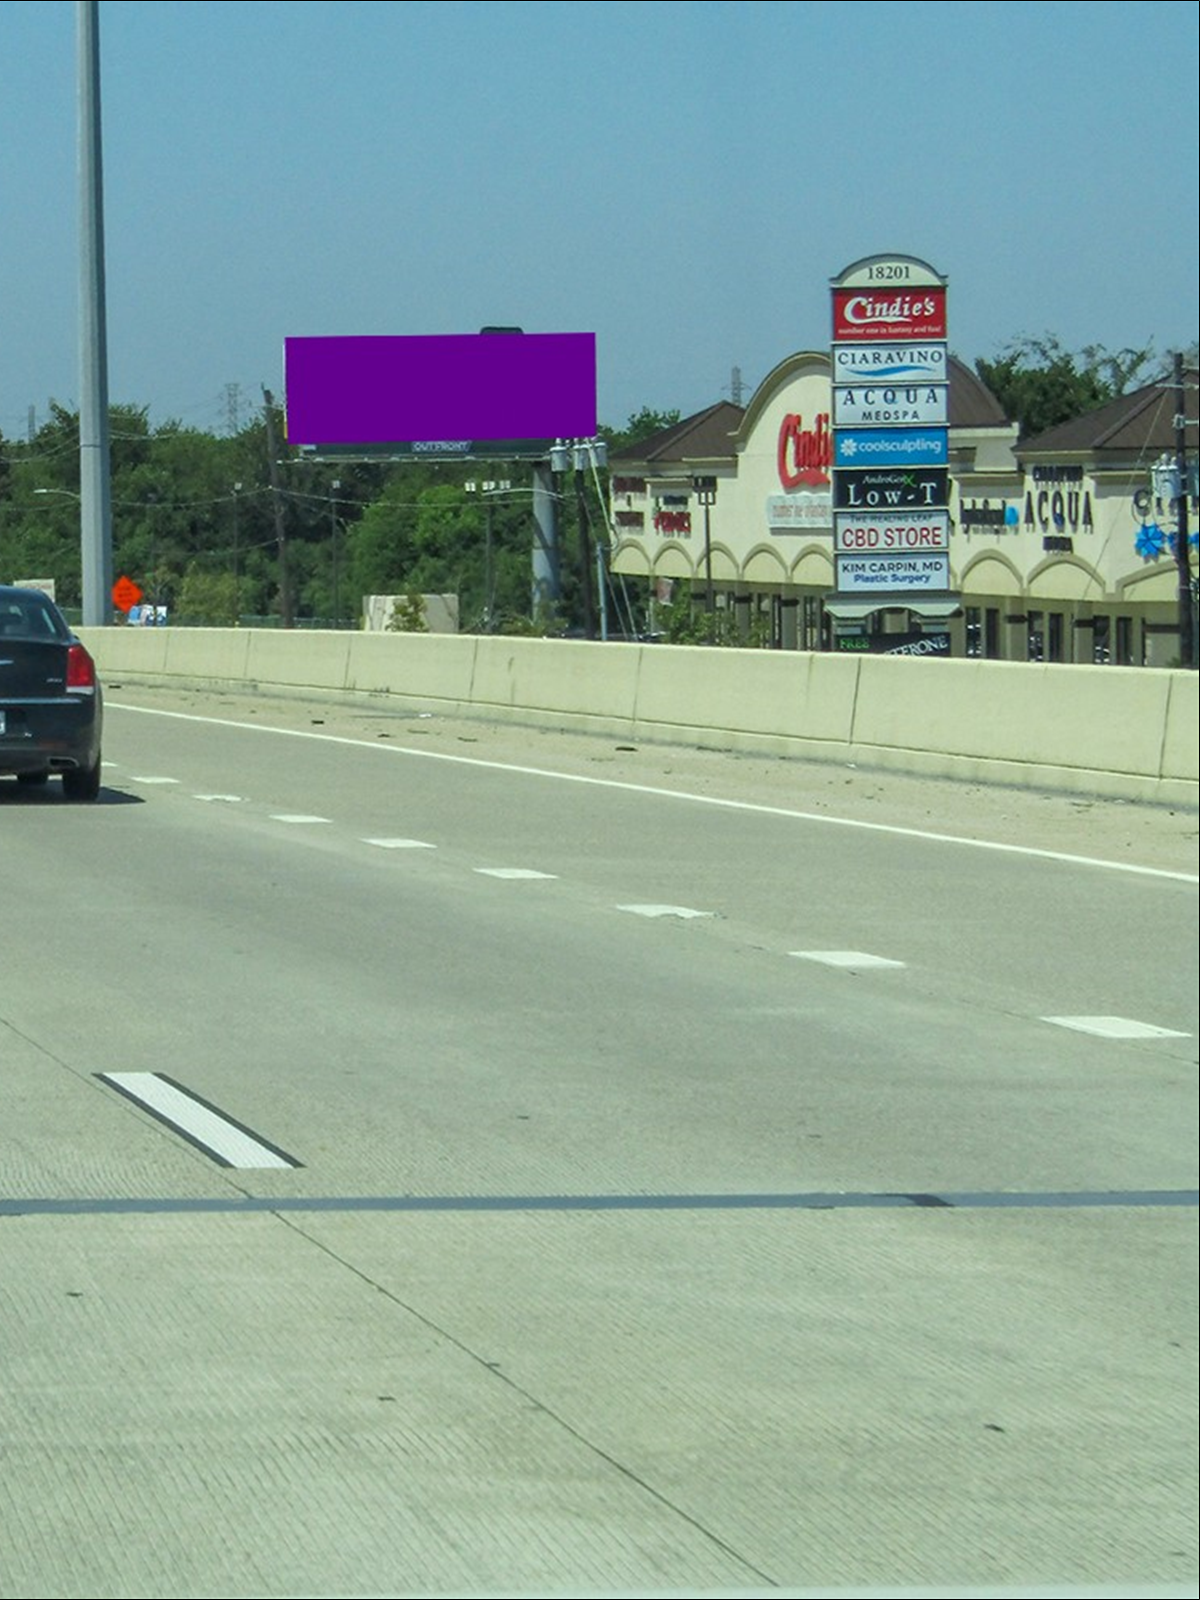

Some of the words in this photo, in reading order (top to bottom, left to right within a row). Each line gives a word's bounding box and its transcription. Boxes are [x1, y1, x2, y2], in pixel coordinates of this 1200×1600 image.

[867, 266, 910, 279] 18201
[843, 296, 935, 324] Cindie's
[913, 325, 927, 333] and
[838, 350, 943, 365] CIARAVINO
[843, 388, 938, 406] ACQUA
[861, 410, 920, 421] MEDSPA
[859, 438, 942, 454] coolsculpting
[1024, 490, 1093, 527] ACQUA
[842, 528, 879, 547] CBD
[884, 526, 942, 546] STORE
[842, 563, 866, 573] KIM
[869, 562, 920, 573] CARPIN,
[922, 561, 943, 571] MD
[854, 574, 888, 583] Plastic
[891, 573, 931, 584] Surgery
